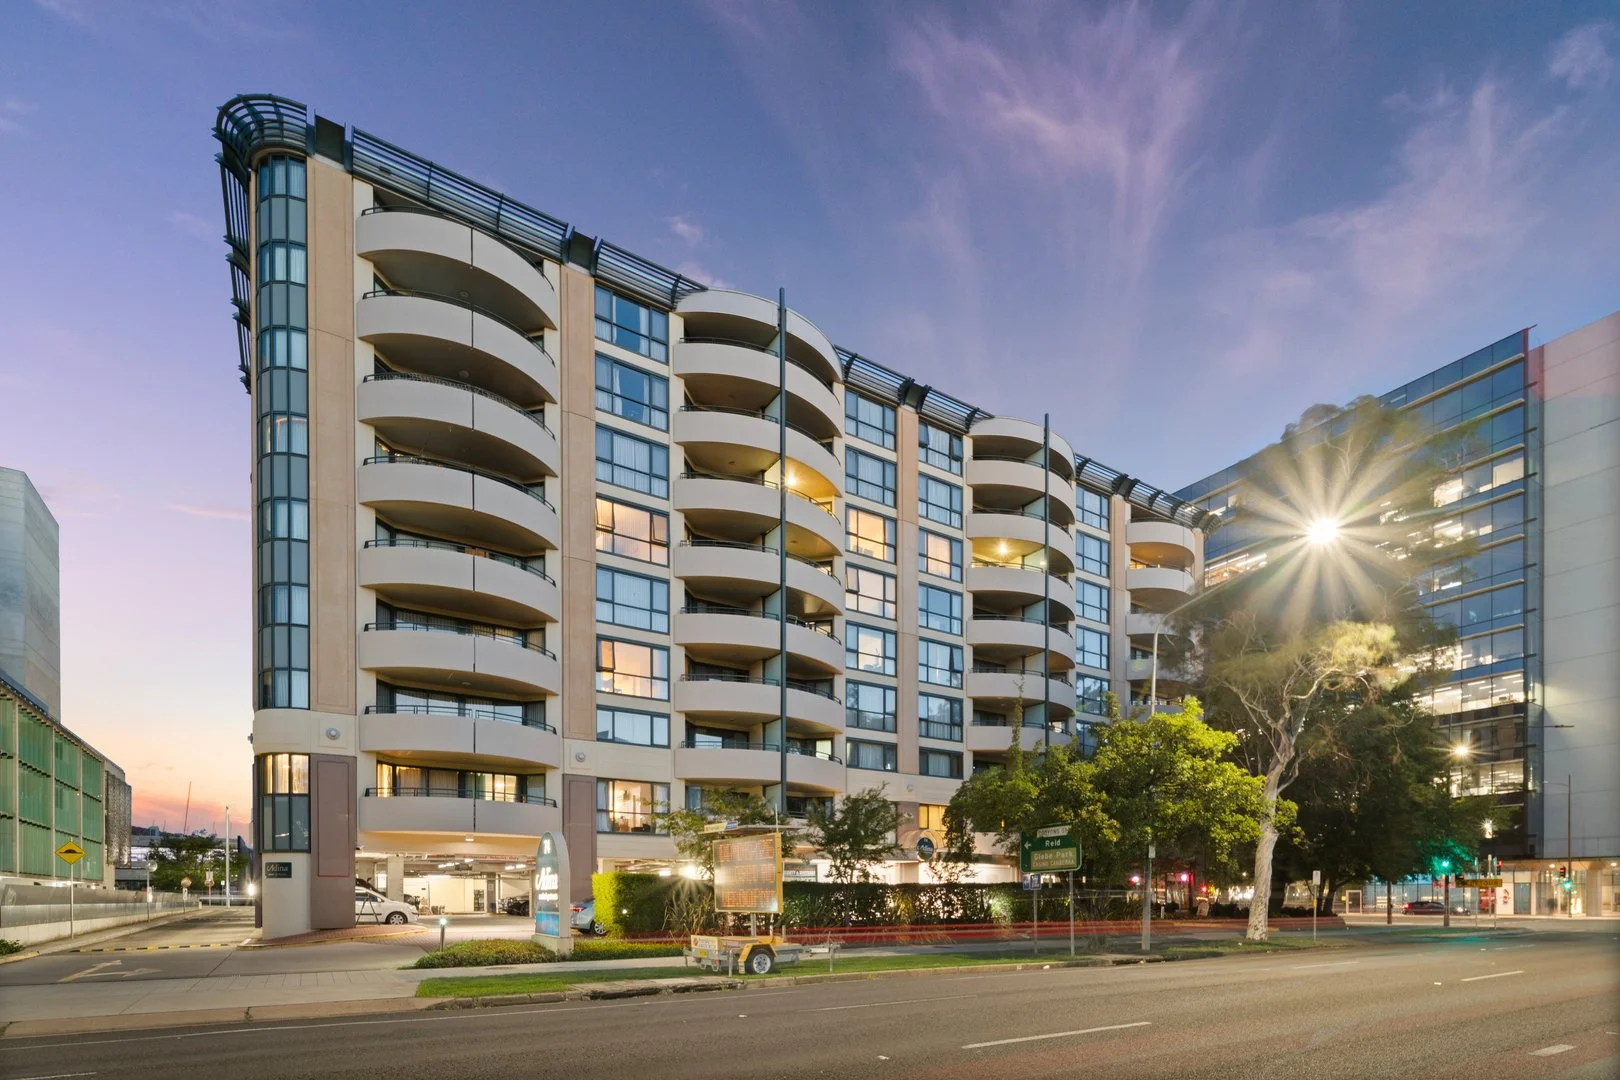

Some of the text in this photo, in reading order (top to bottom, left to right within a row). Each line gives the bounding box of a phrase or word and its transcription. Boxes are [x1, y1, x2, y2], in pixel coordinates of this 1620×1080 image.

[1045, 839, 1061, 847] Reid
[1034, 852, 1053, 861] Glebe
[267, 864, 289, 872] Adina
